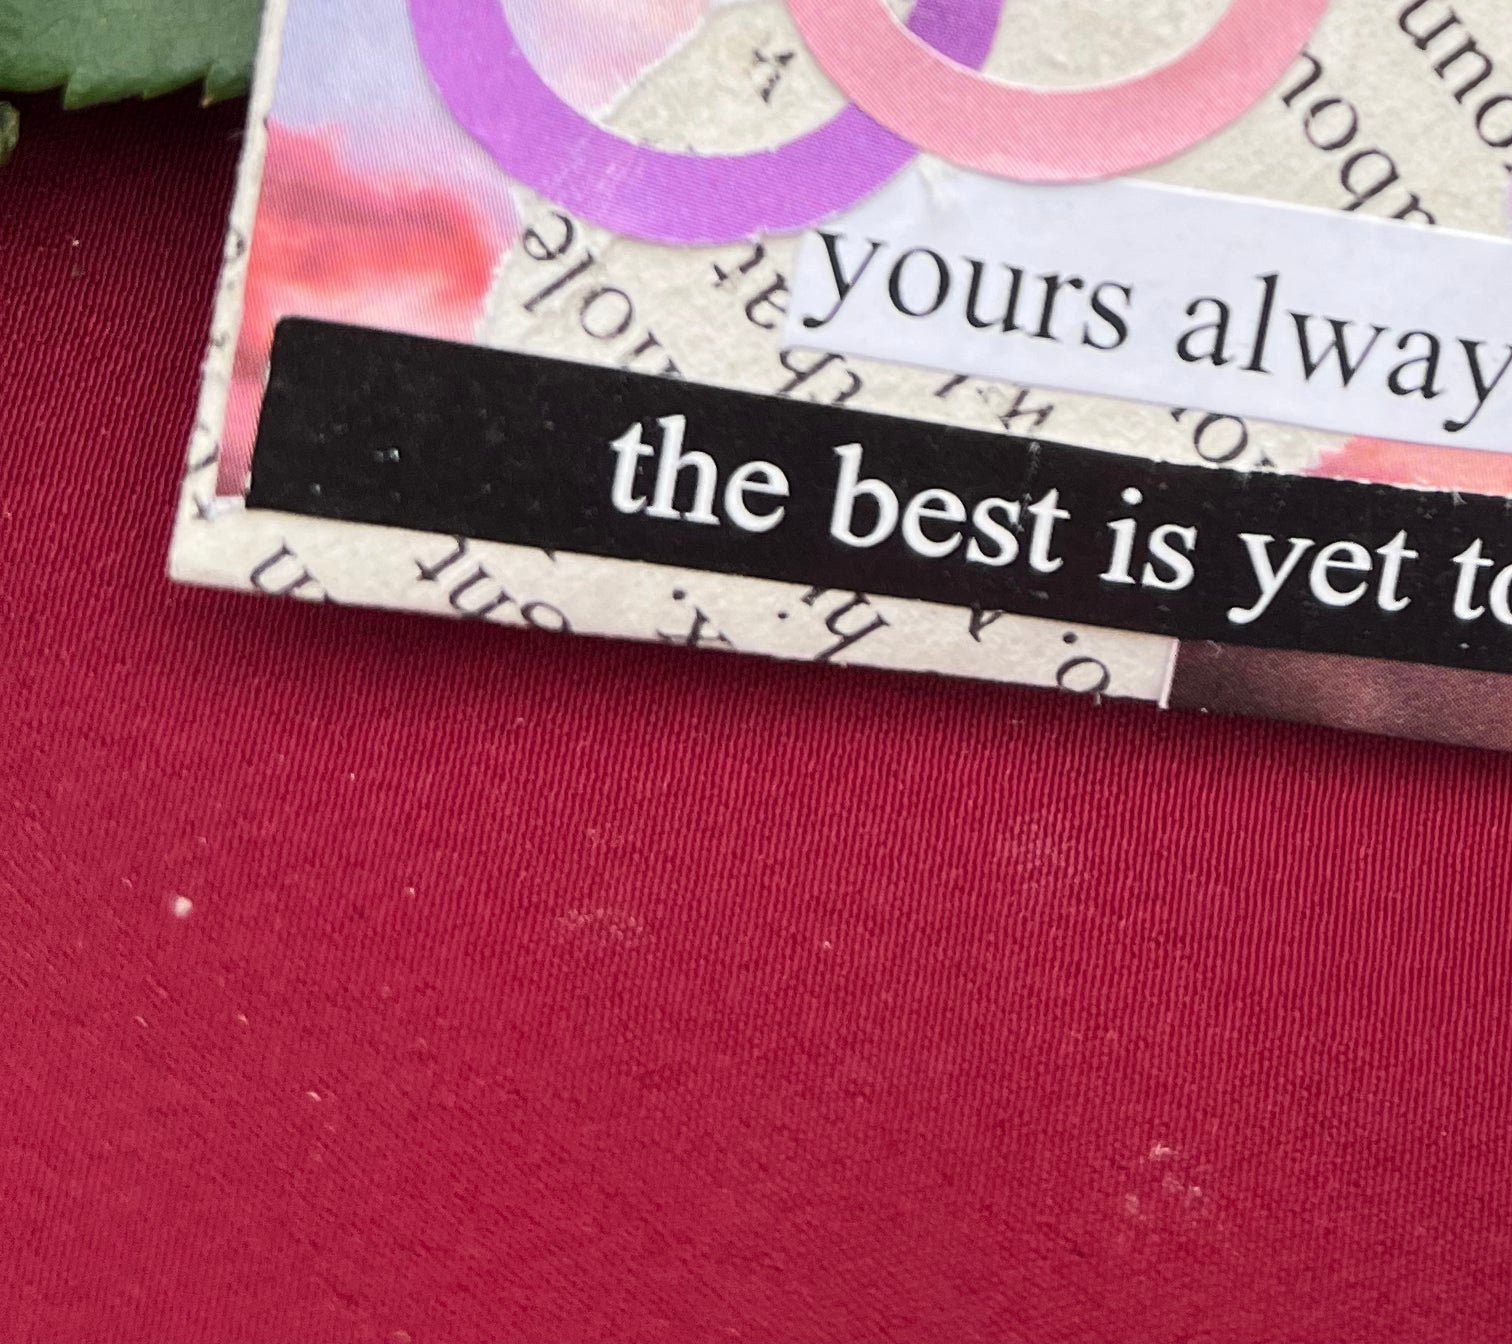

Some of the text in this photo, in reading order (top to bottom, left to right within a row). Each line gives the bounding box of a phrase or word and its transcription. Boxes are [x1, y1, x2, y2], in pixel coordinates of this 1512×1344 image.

[802, 229, 1134, 352] yours
[610, 413, 790, 533] the
[829, 442, 1072, 575] best
[1098, 486, 1198, 592] is
[1226, 529, 1420, 624] yet
